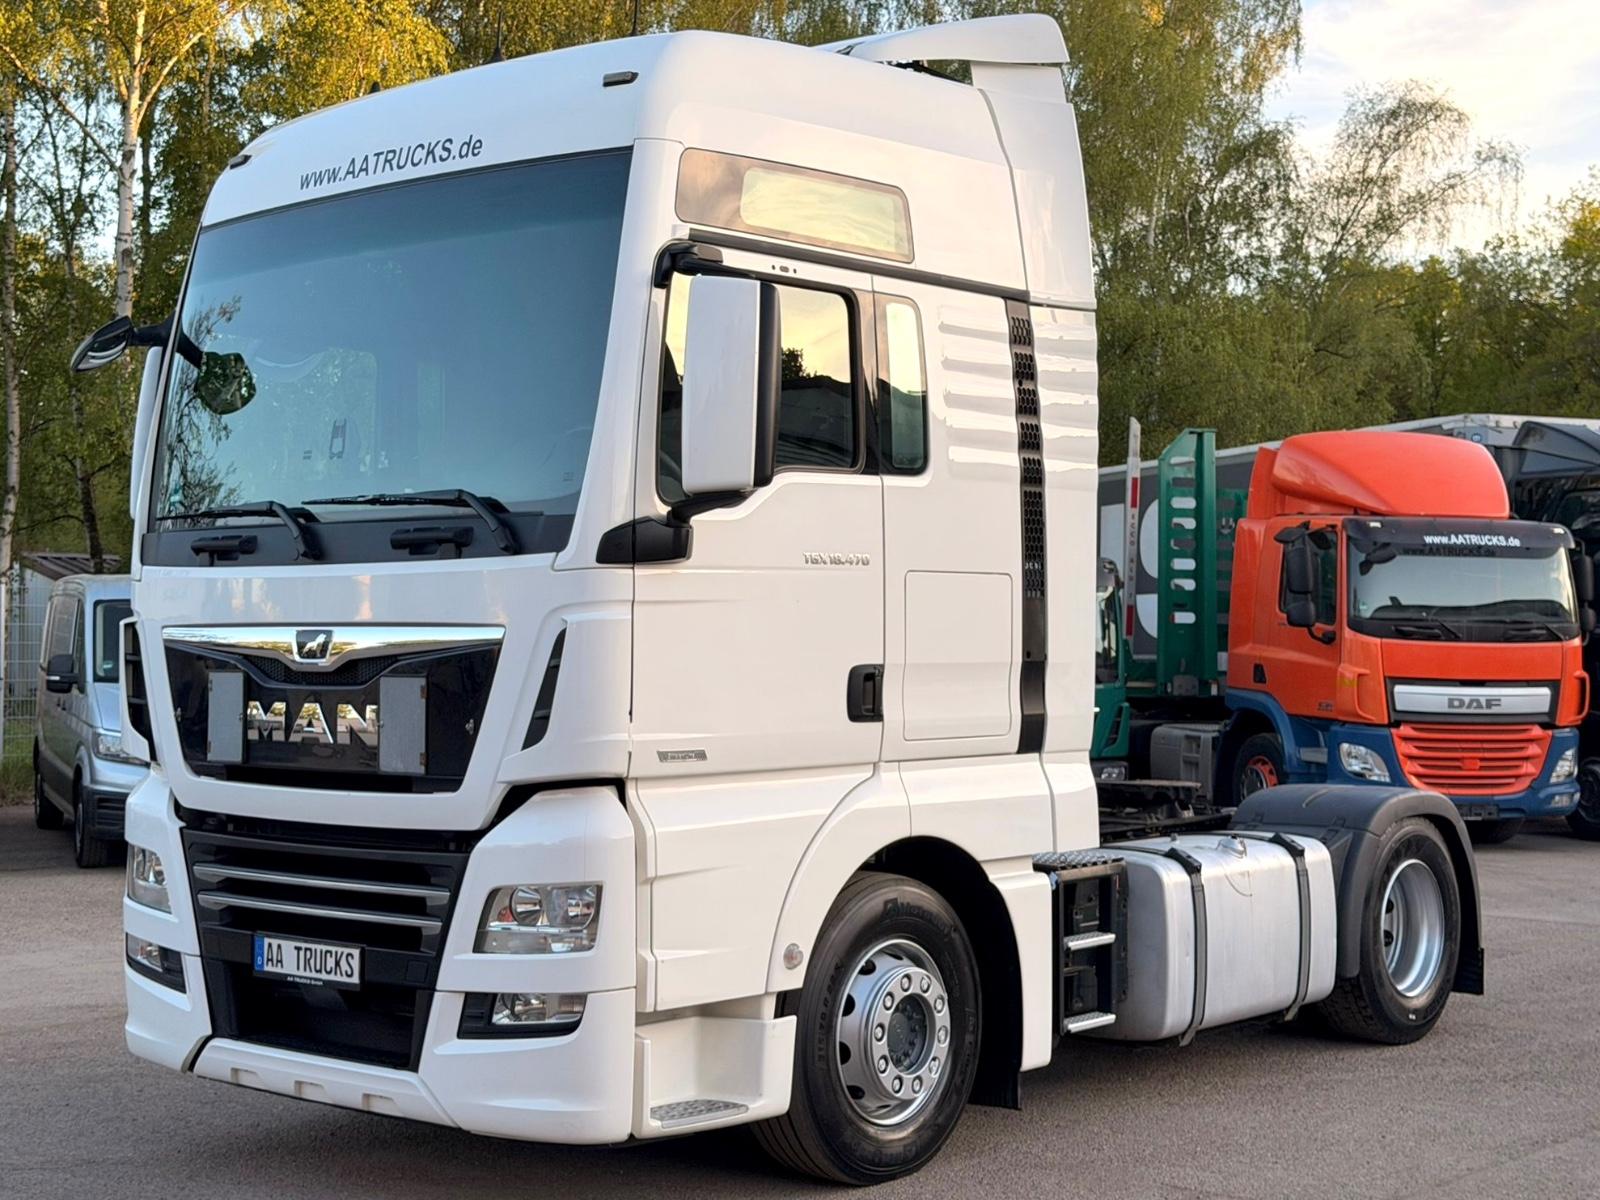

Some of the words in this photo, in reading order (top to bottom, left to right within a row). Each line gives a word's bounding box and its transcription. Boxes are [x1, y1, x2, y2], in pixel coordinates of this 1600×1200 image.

[299, 134, 483, 191] www.AATRUCKS.de
[1423, 534, 1521, 547] www.AATRUCKS.de
[1447, 697, 1502, 710] DAF
[247, 701, 378, 746] MAN
[265, 942, 284, 969] AA
[294, 946, 355, 979] TRUCKS
